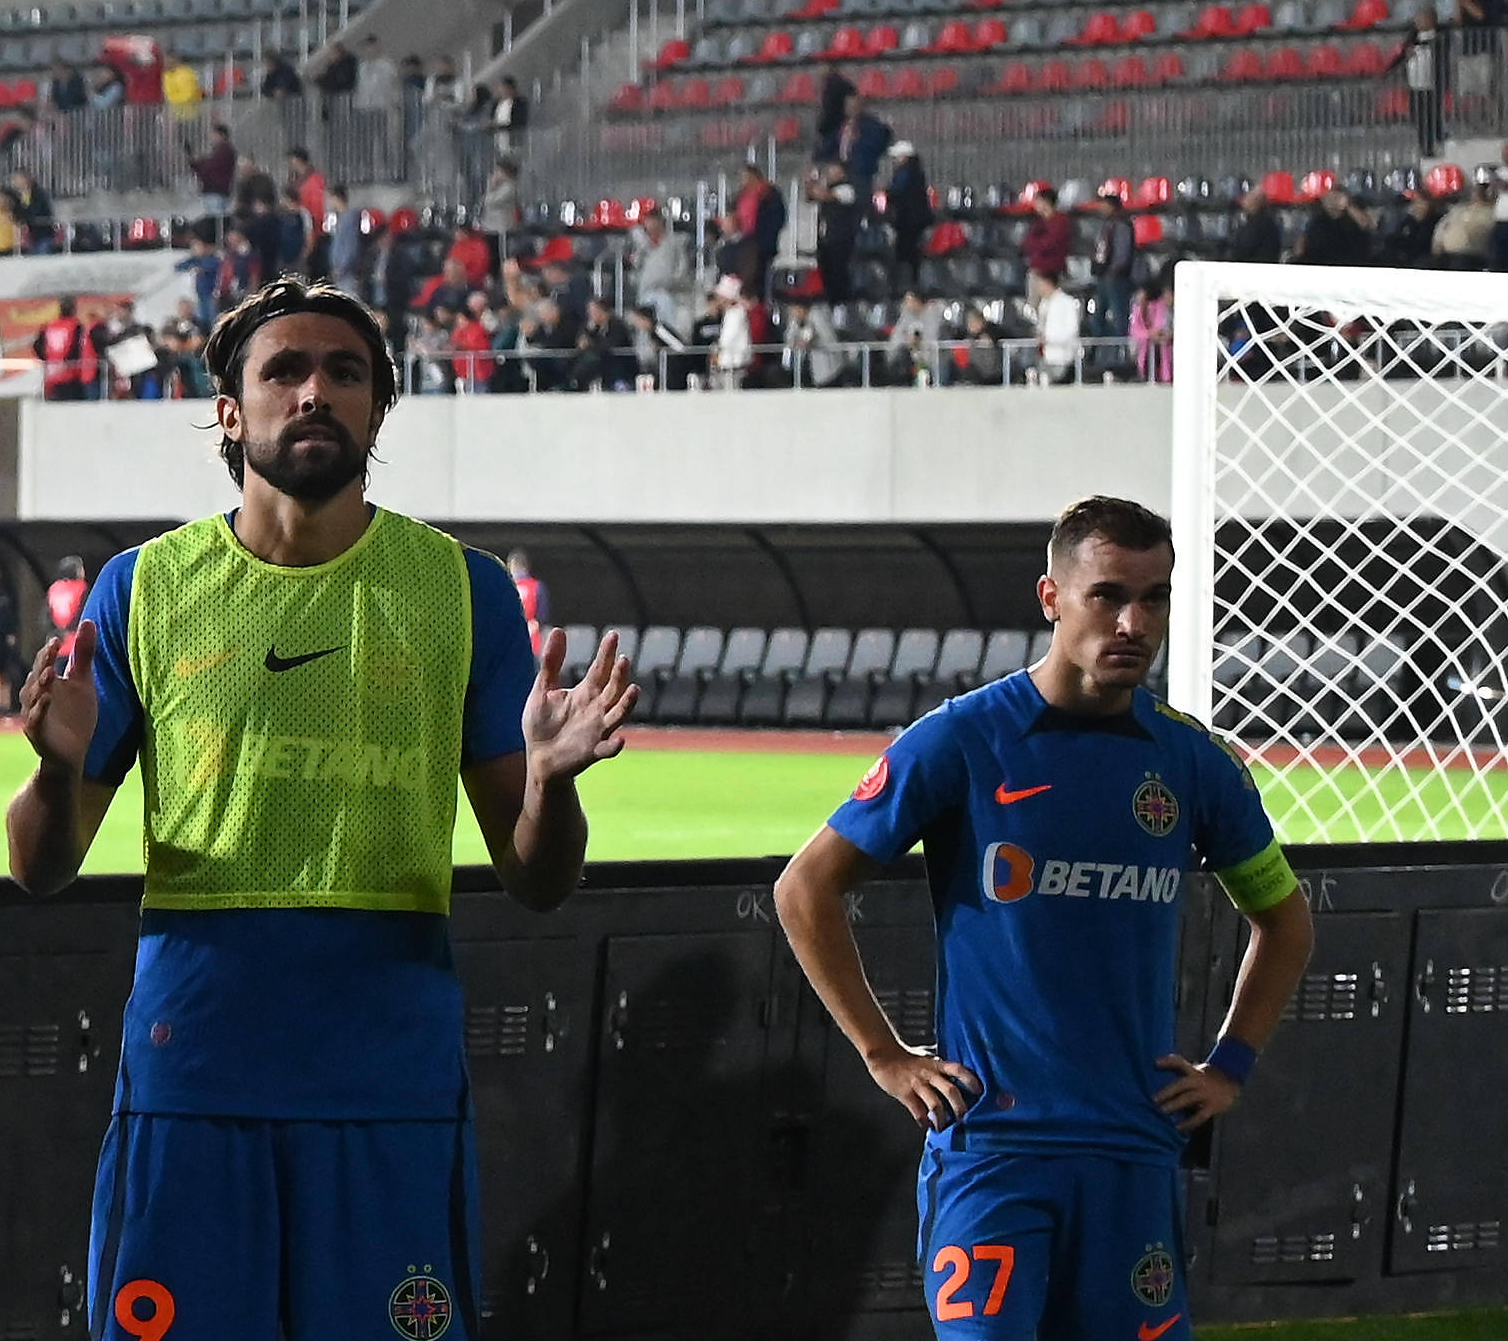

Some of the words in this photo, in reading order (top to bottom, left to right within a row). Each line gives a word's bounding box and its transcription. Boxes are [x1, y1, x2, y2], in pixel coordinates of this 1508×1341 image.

[1036, 858, 1181, 905] BETANO
[737, 890, 771, 923] OK
[933, 1244, 1016, 1321] 27
